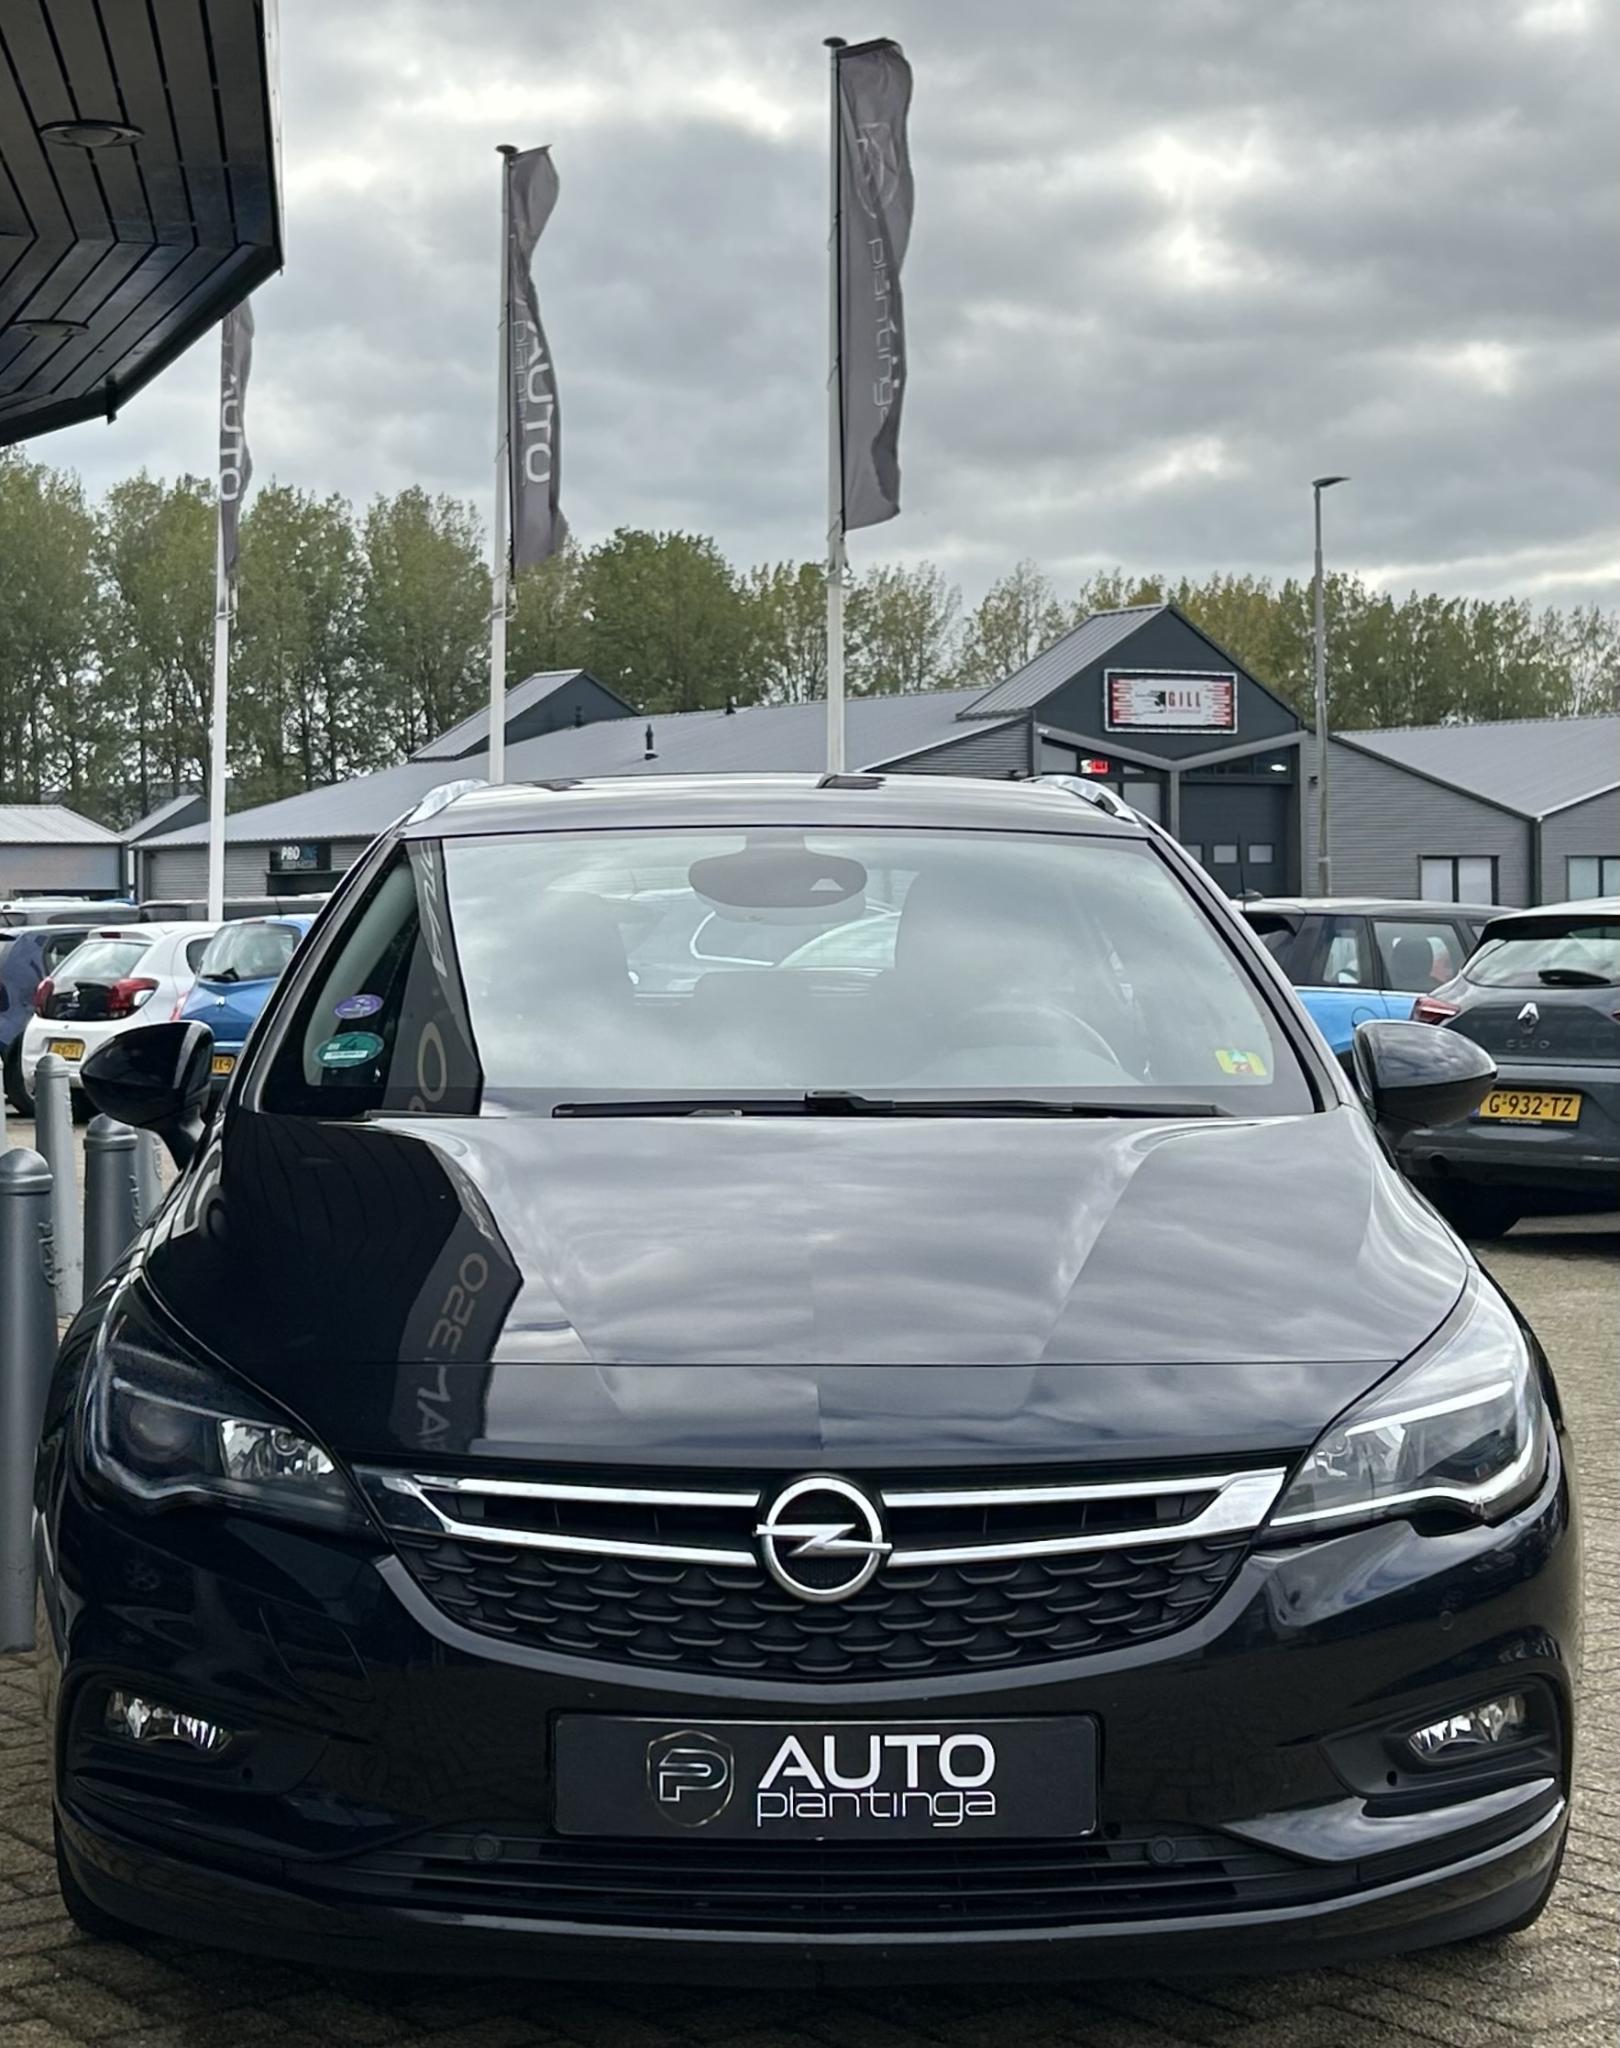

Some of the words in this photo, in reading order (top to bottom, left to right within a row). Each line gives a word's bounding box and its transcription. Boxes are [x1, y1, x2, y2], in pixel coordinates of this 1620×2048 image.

[1168, 691, 1202, 707] GILL
[1488, 1093, 1575, 1117] G-932-TZ
[757, 1733, 996, 1789] AUTO
[756, 1786, 997, 1828] plantinga
